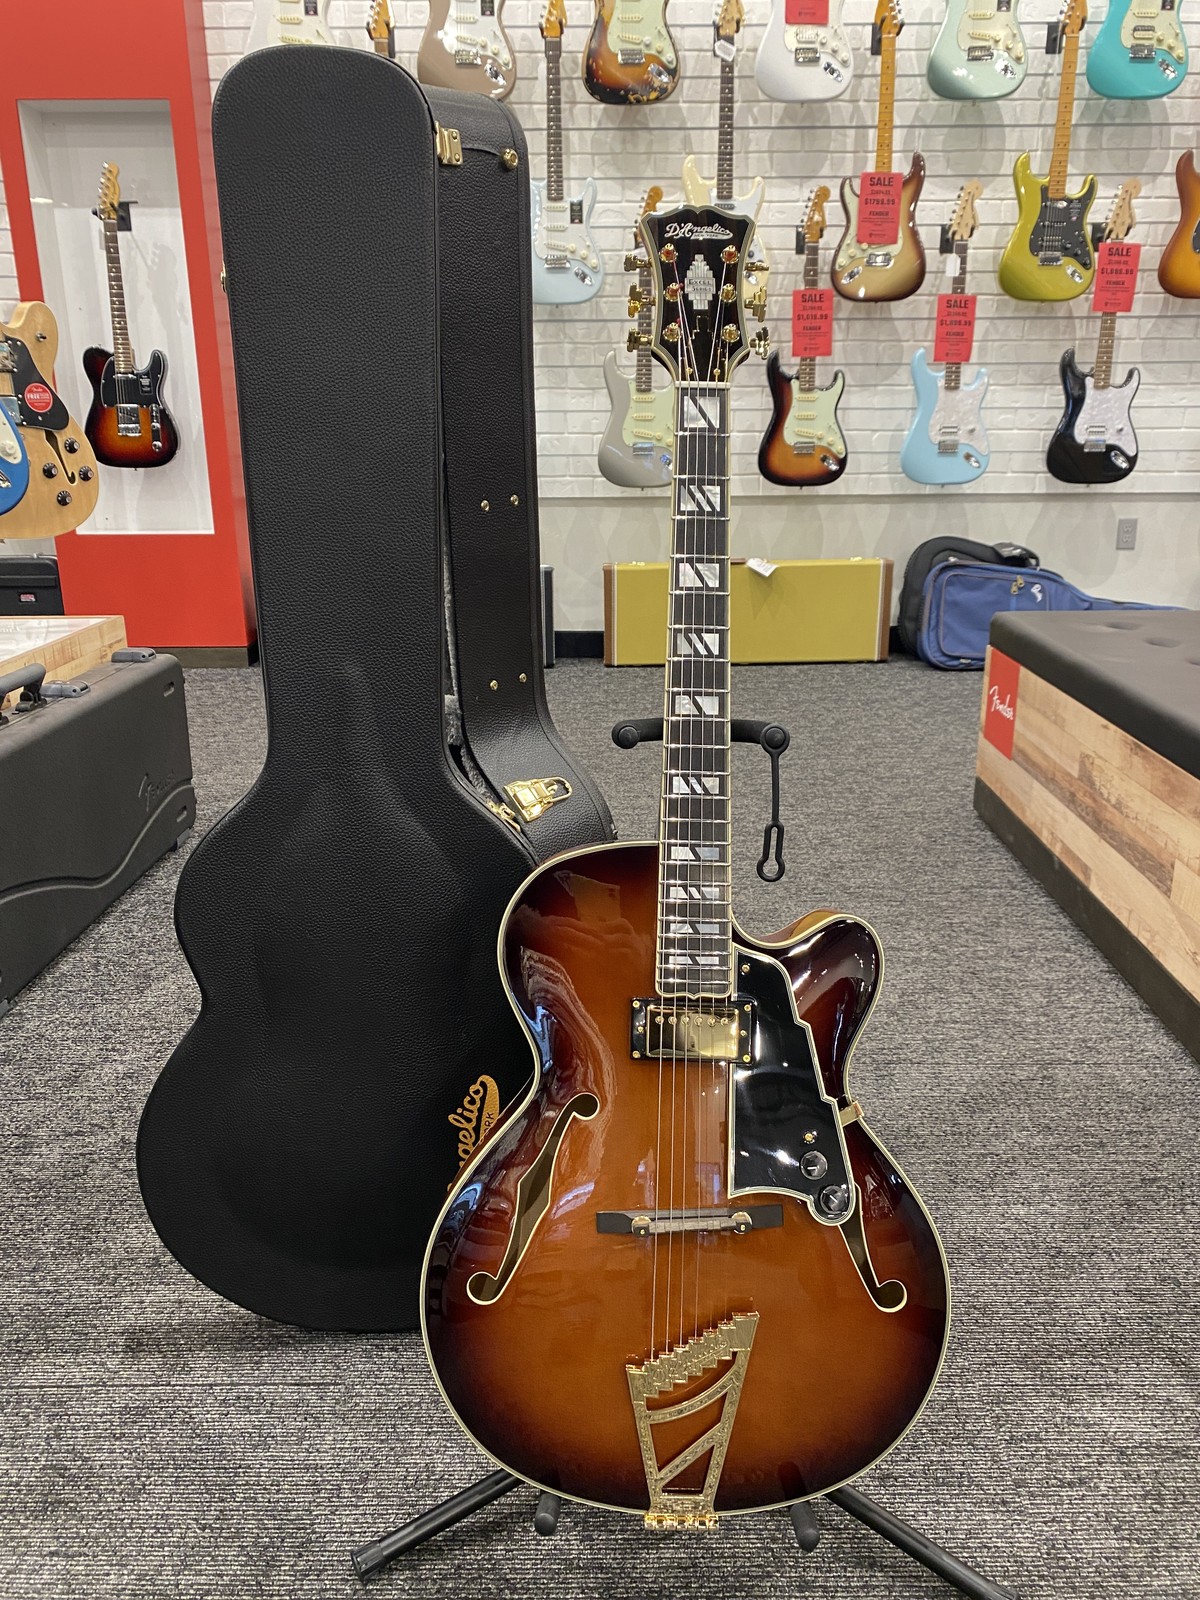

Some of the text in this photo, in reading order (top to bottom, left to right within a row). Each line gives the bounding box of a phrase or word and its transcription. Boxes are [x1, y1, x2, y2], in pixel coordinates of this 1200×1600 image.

[869, 176, 894, 187] SALE
[664, 222, 733, 239] D'Angelico
[1108, 247, 1132, 257] SALE
[801, 293, 825, 303] SALE
[946, 299, 969, 309] SALE
[989, 685, 1014, 721] Fender
